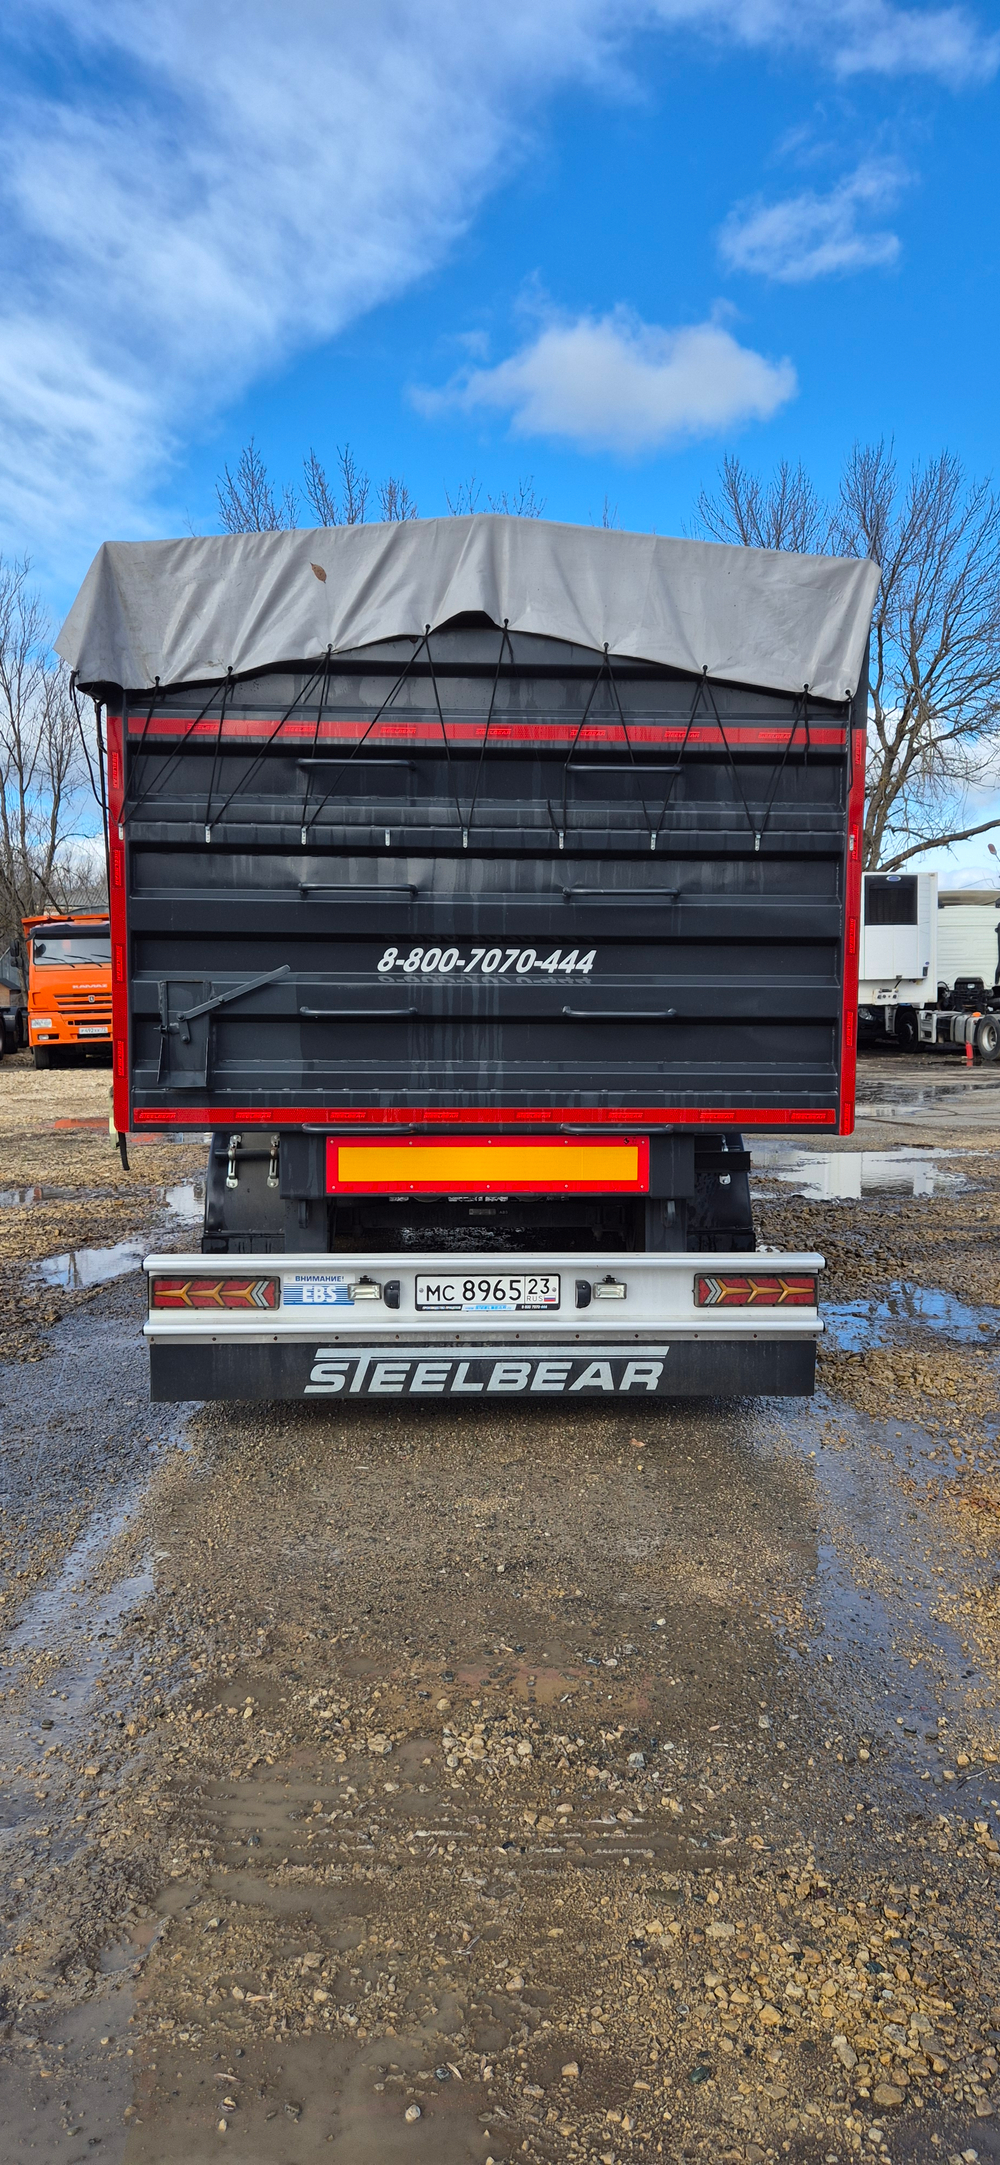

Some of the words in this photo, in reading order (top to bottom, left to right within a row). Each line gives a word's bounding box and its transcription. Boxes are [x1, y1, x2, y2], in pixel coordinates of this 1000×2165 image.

[377, 948, 597, 974] 8-800-7070-444
[302, 1285, 337, 1303] EBS
[462, 1279, 522, 1301] 8965
[528, 1278, 550, 1294] 23
[303, 1346, 669, 1394] STEELBEAR
